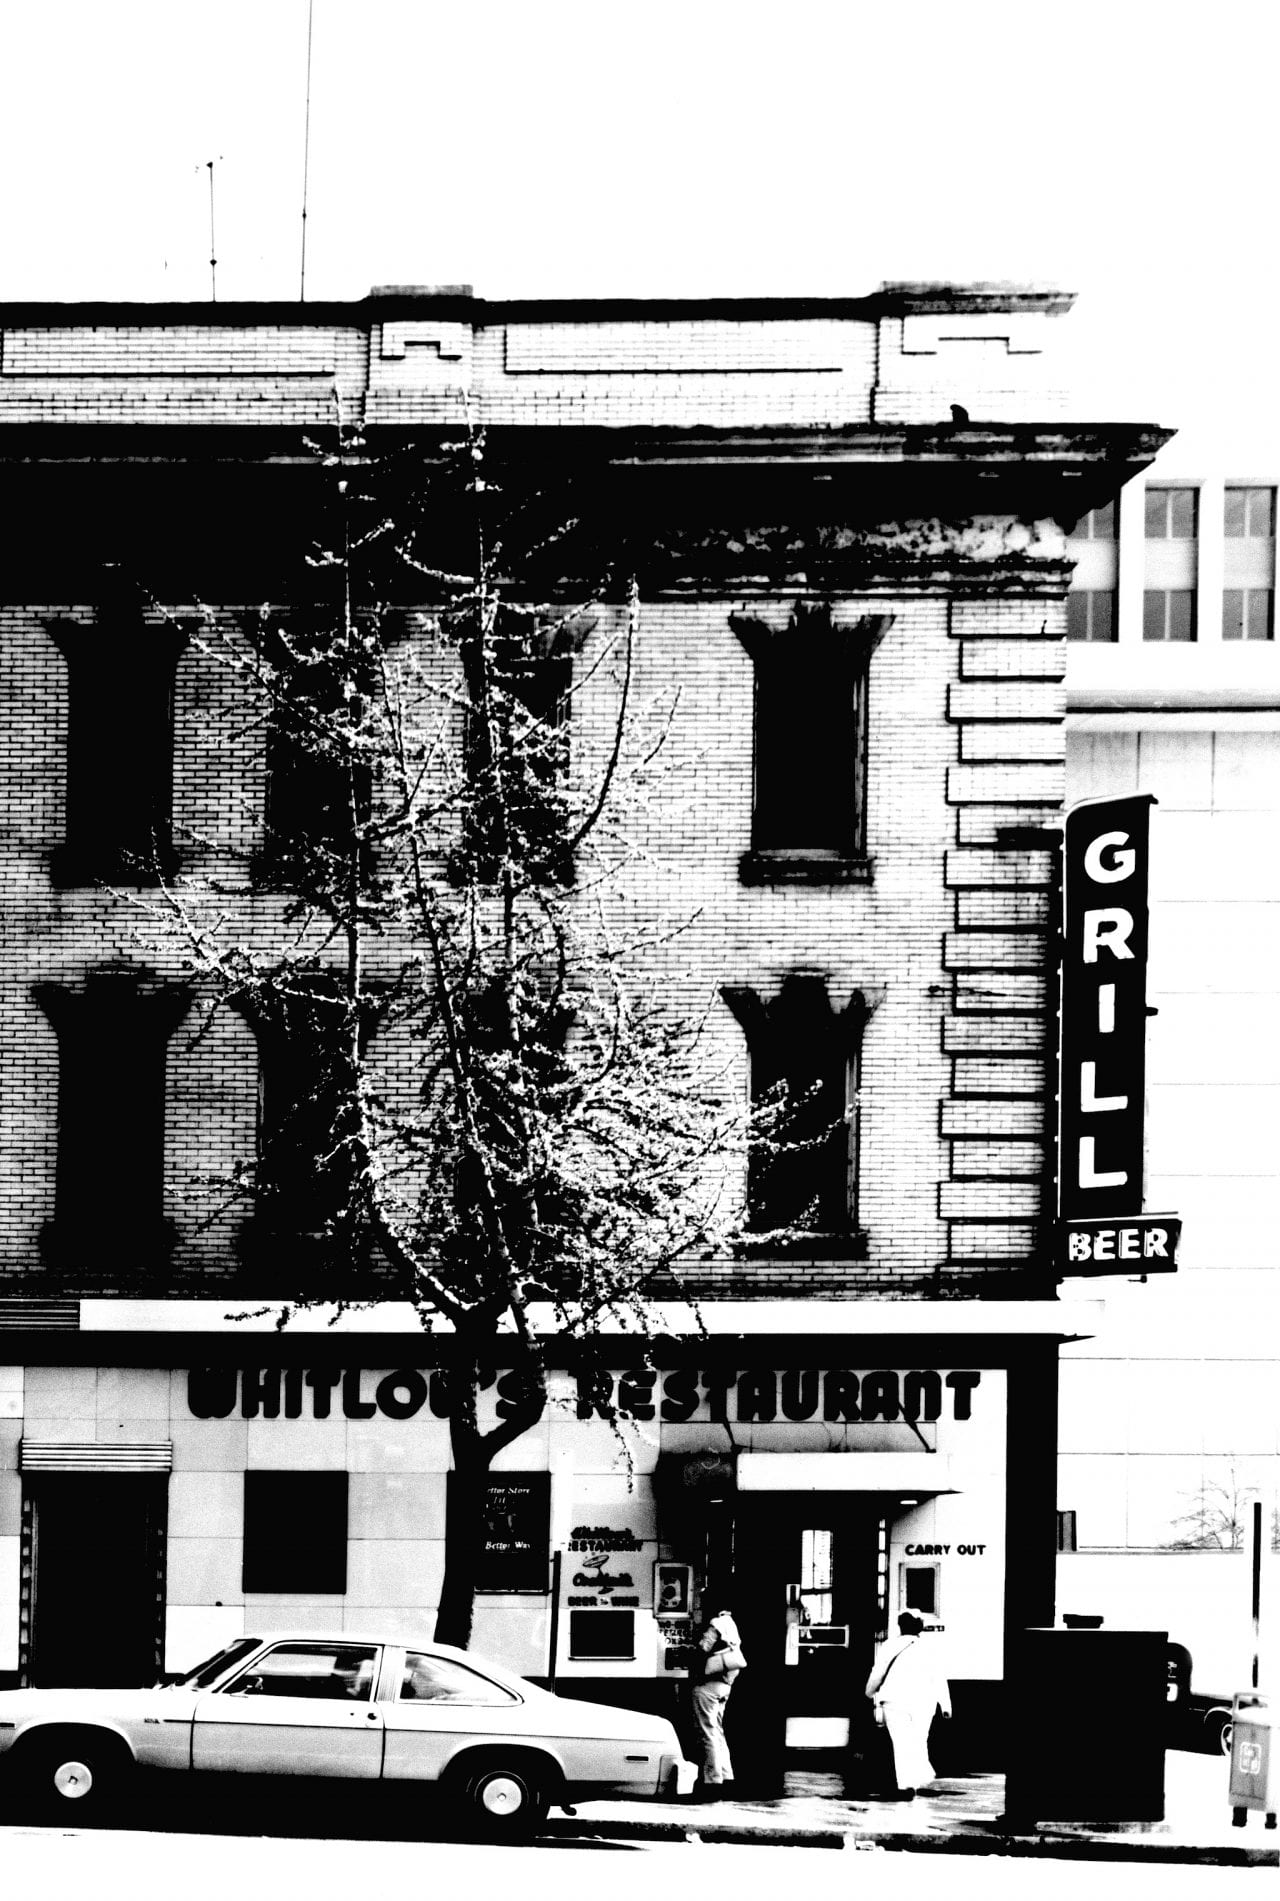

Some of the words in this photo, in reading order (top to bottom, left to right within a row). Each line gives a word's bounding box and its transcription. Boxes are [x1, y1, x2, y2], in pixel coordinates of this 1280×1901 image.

[1078, 831, 1136, 1189] GRILL
[1068, 1228, 1169, 1261] BEER
[567, 1370, 981, 1421] RESTAURANT
[905, 1544, 951, 1556] CARRY
[957, 1544, 987, 1556] OUT
